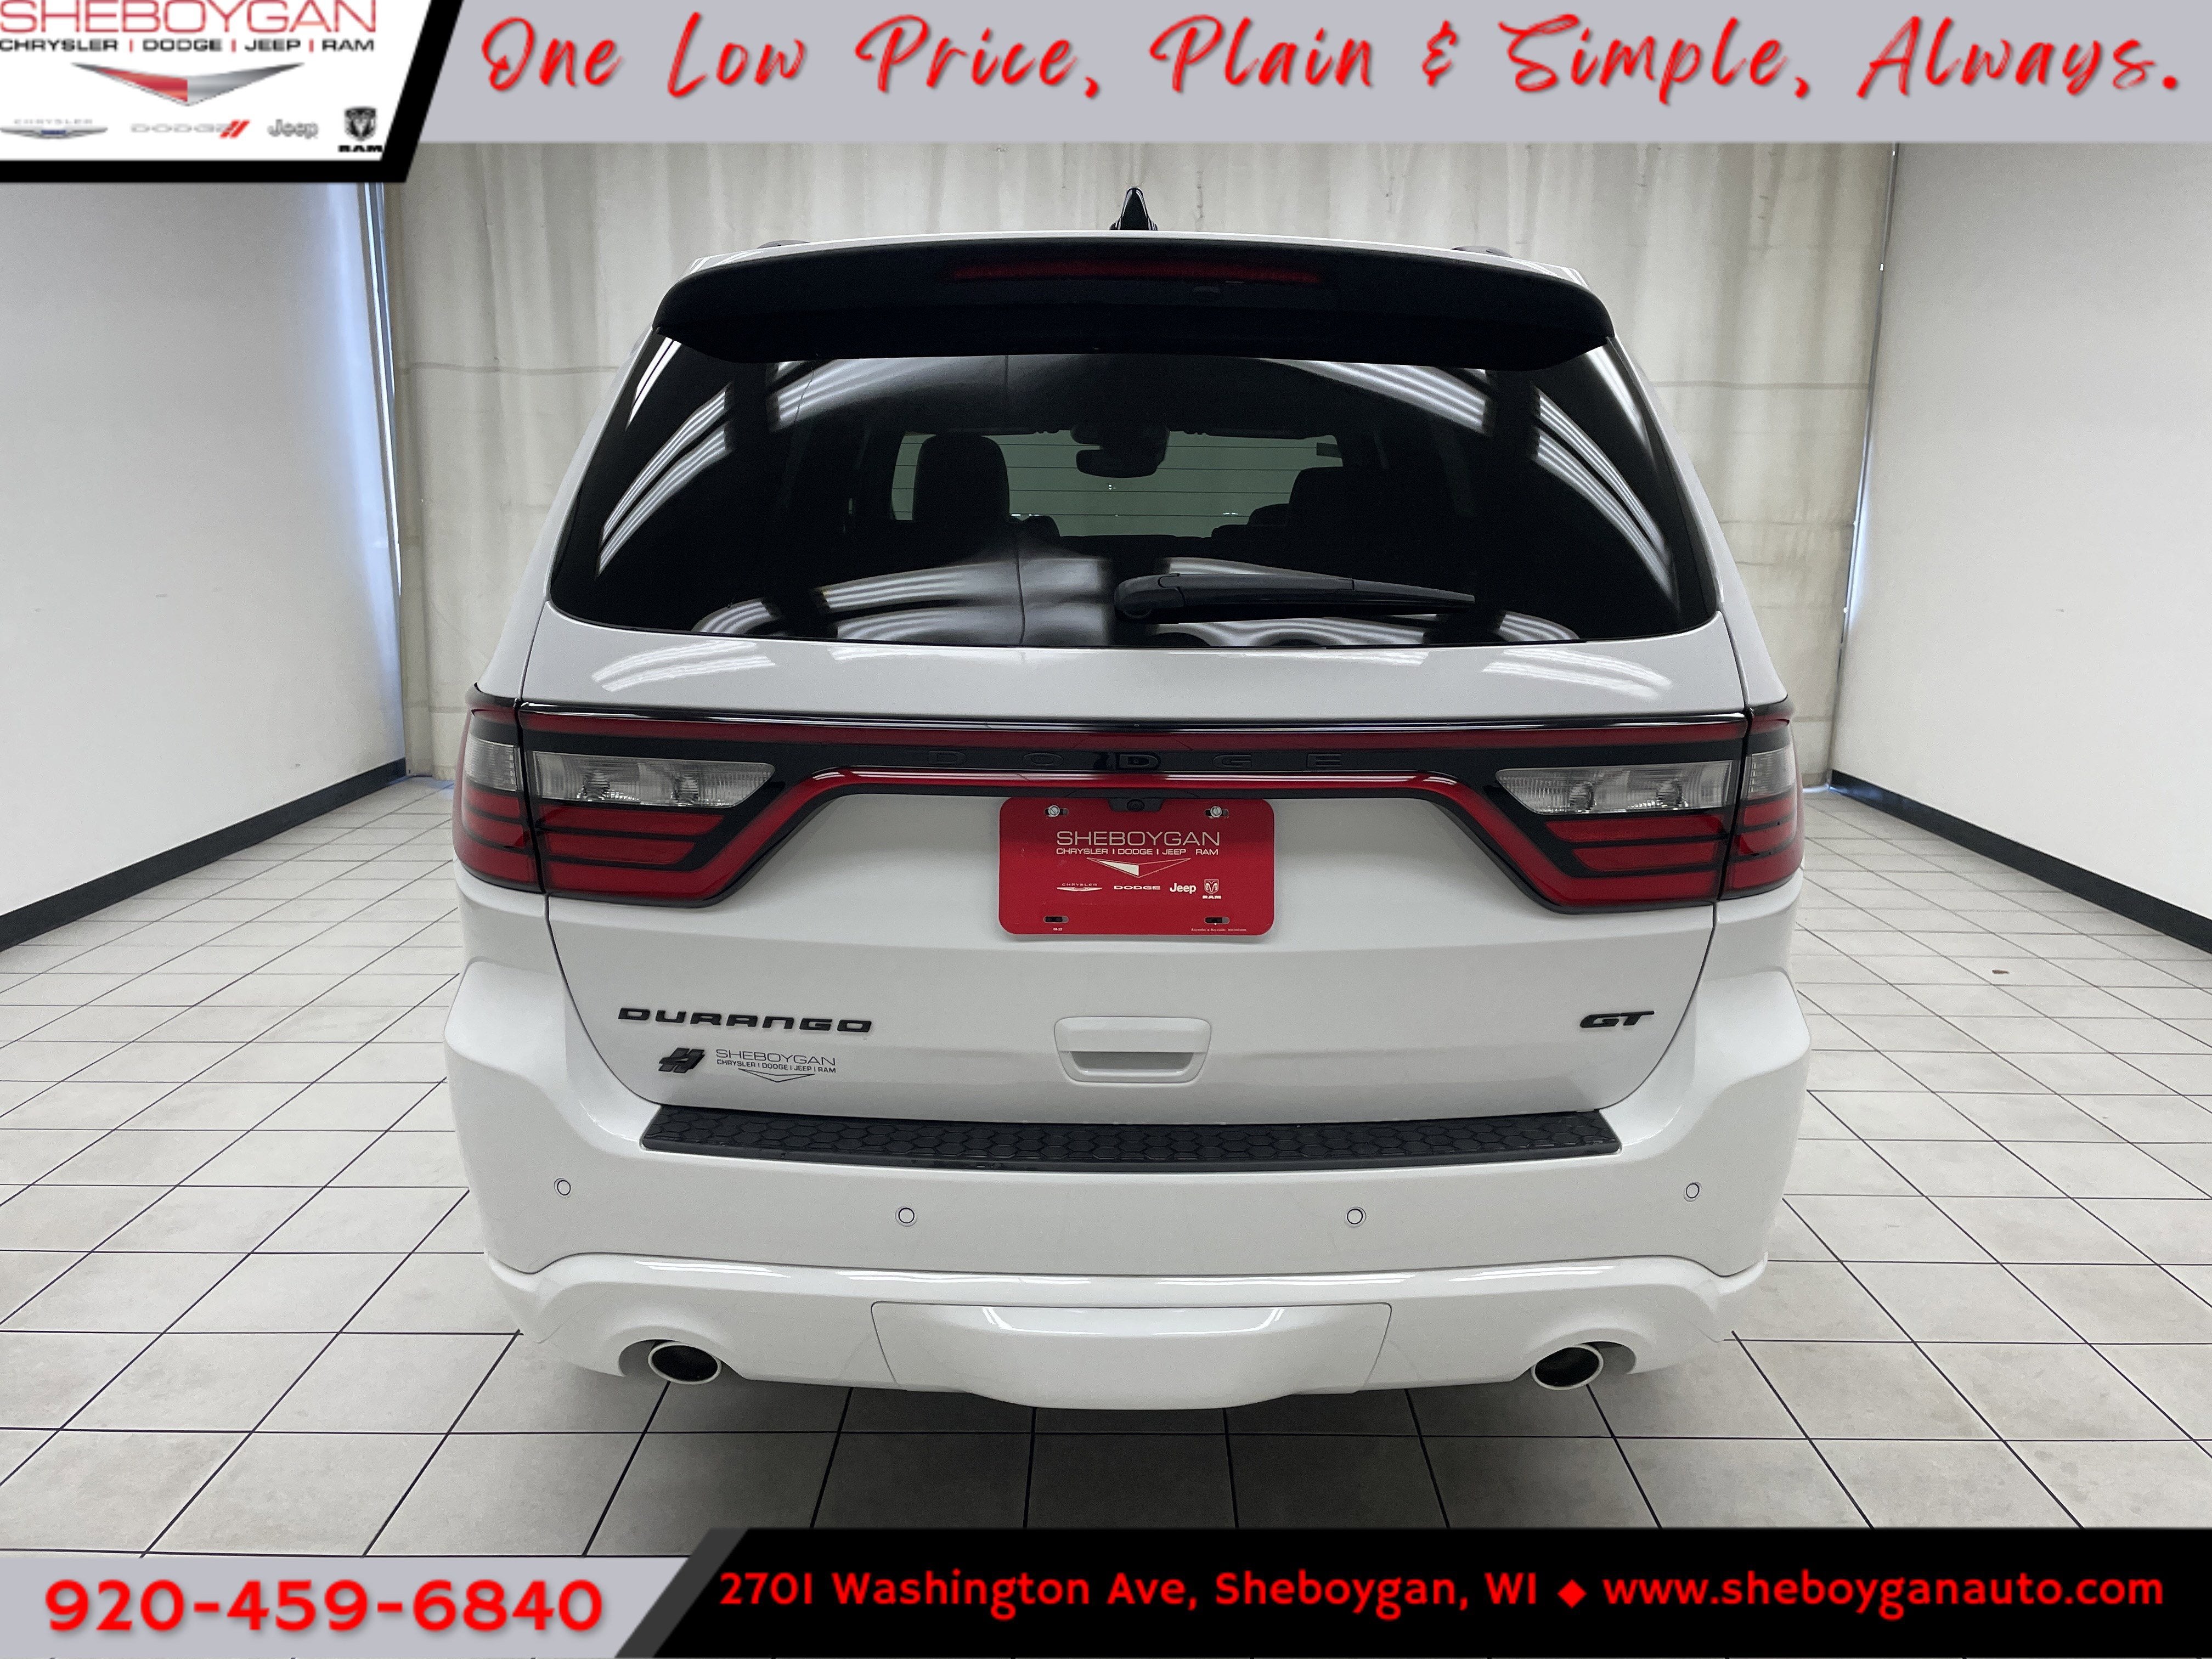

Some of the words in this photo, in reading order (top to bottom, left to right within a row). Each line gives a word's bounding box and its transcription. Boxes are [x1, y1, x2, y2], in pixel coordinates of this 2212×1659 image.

[1056, 831, 1220, 846] SHEBOYGAN
[1169, 883, 1197, 894] Jeep
[618, 1007, 872, 1033] DURANGO
[1579, 1011, 1655, 1028] GT
[716, 1049, 836, 1065] SHEBOYGAN
[716, 1059, 756, 1068] CHRYSLER
